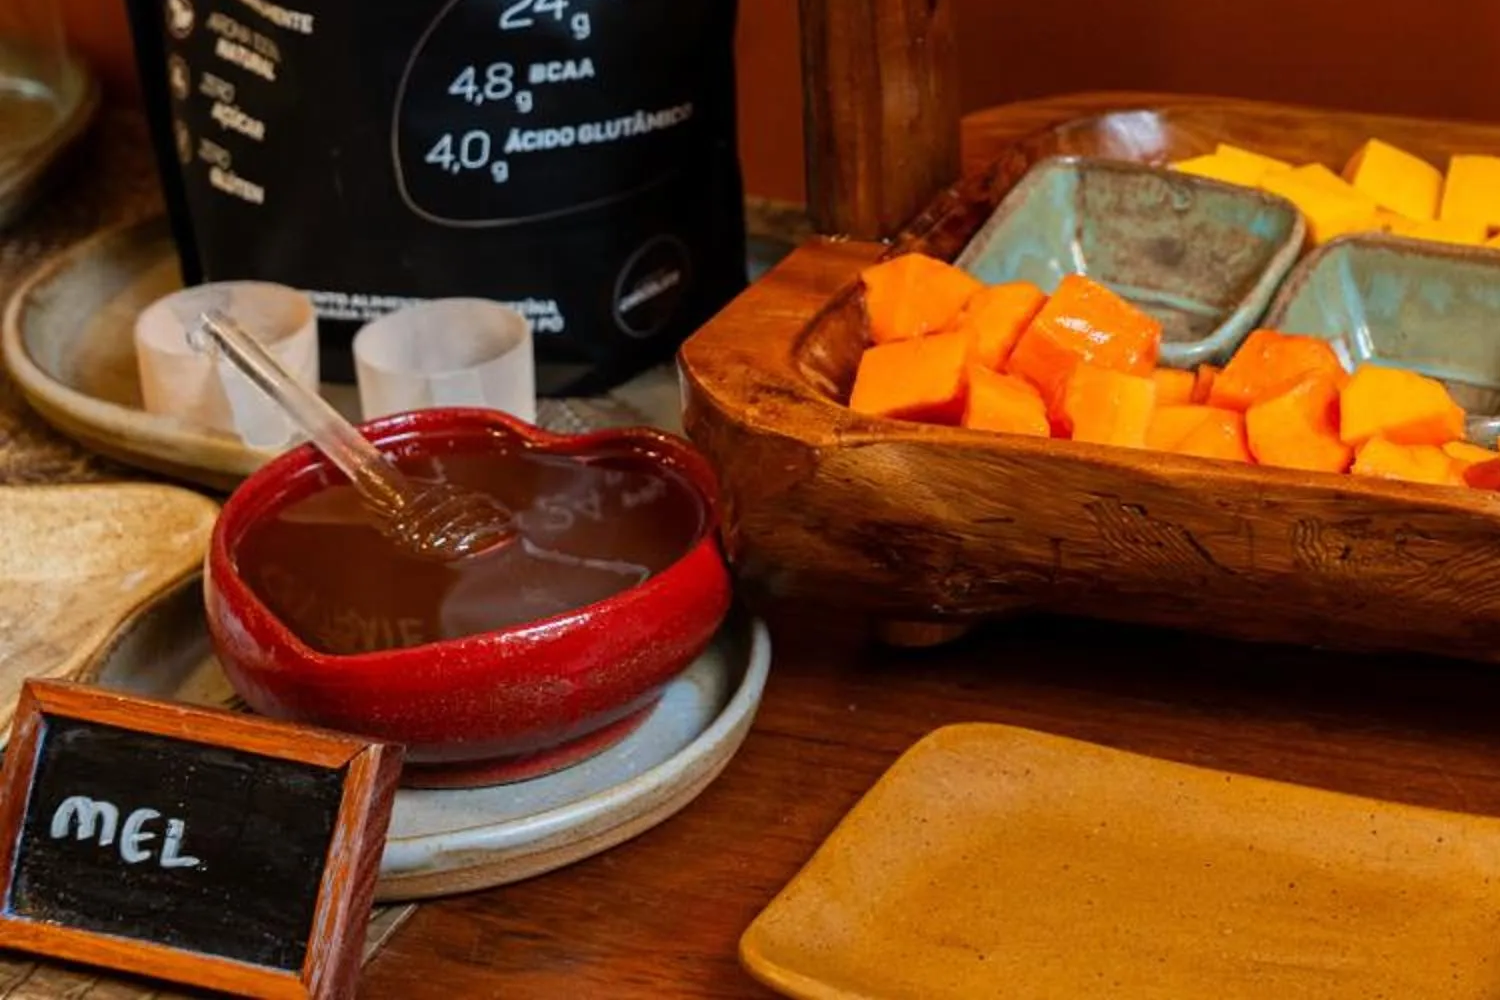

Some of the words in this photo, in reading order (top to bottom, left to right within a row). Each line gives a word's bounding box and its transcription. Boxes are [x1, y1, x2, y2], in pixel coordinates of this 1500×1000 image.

[527, 57, 596, 84] BCAA
[503, 126, 575, 154] ÁCIDO
[51, 795, 200, 868] MEL
